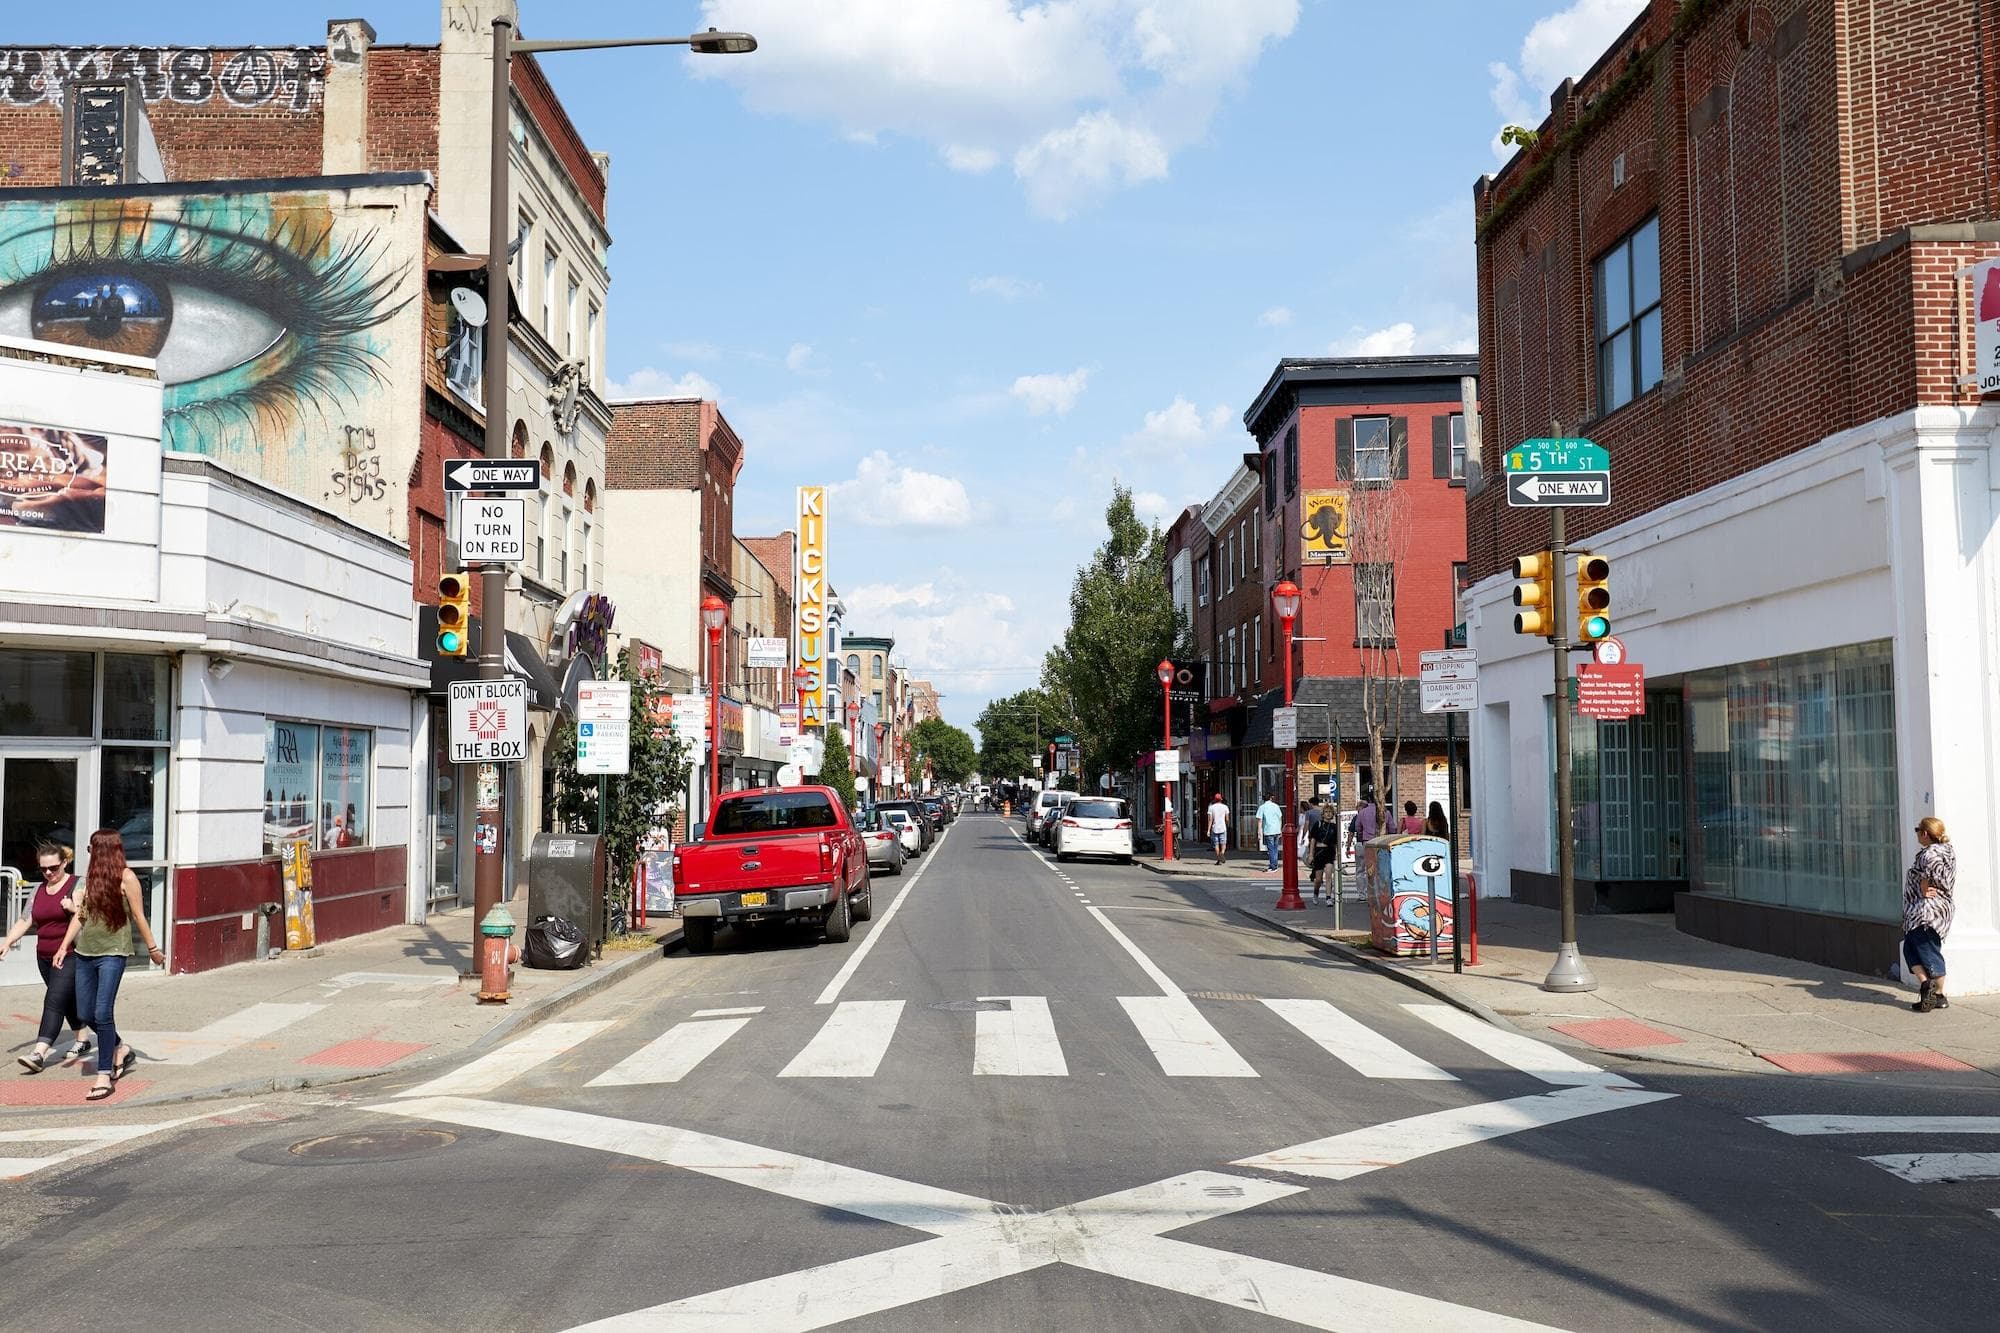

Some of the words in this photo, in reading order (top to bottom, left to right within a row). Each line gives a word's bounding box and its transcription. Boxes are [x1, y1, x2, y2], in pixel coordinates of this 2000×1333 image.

[1554, 441, 1560, 452] S
[0, 451, 67, 474] READ
[1579, 457, 1593, 470] ST
[473, 469, 498, 481] ONE
[503, 469, 529, 481] WAY
[1538, 482, 1564, 494] ONE
[1569, 482, 1597, 494] WAY
[21, 510, 45, 519] SOON
[482, 506, 503, 518] NO
[474, 524, 511, 536] TURN
[466, 541, 485, 553] ON
[491, 541, 519, 553] RED
[801, 490, 821, 633] KICKS
[1435, 663, 1464, 671] STOPPING
[486, 683, 522, 698] BLOCK
[1427, 684, 1454, 692] LOADING
[1456, 683, 1472, 691] ONLY
[456, 742, 482, 758] THE
[491, 741, 521, 757] BOX
